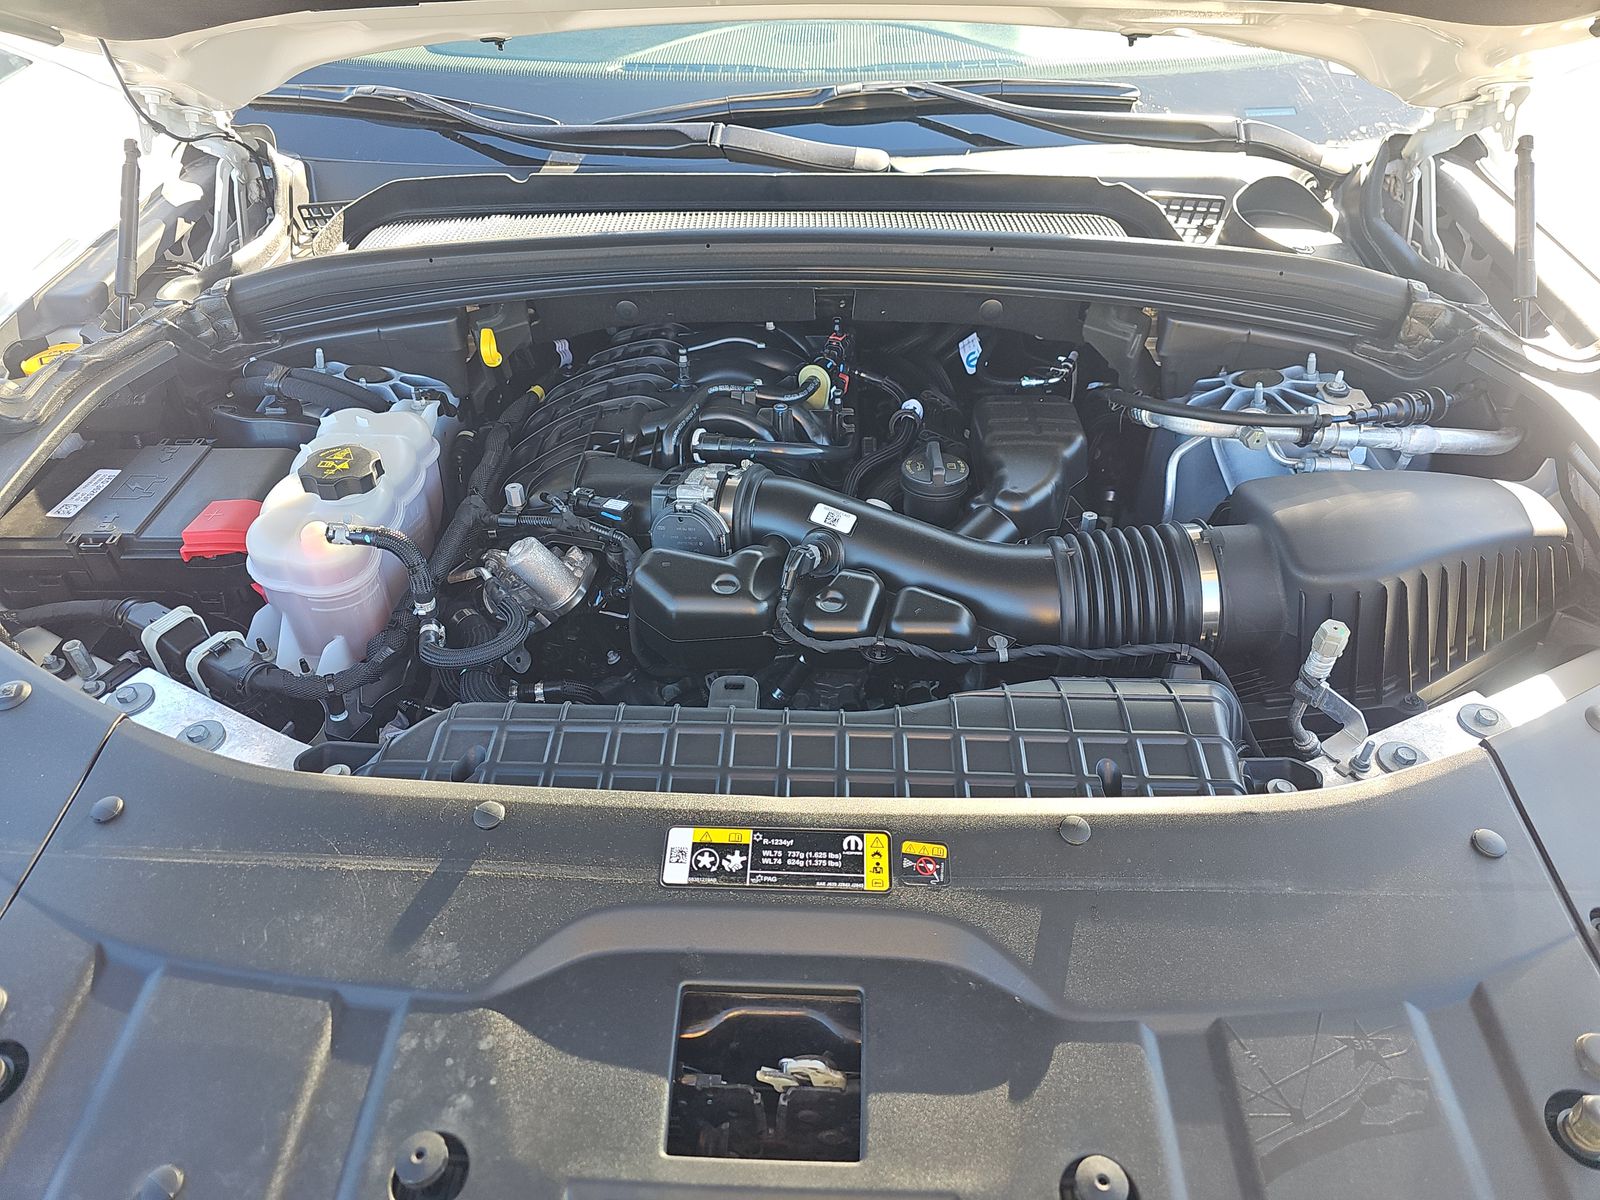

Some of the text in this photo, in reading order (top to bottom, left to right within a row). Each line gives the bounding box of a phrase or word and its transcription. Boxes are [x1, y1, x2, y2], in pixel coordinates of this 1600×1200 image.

[787, 851, 804, 859] 737g
[805, 851, 827, 859] (1.625
[828, 852, 842, 860] lbs)
[786, 859, 804, 867] 624g
[805, 859, 827, 867] (1.375
[828, 860, 842, 868] lbs)
